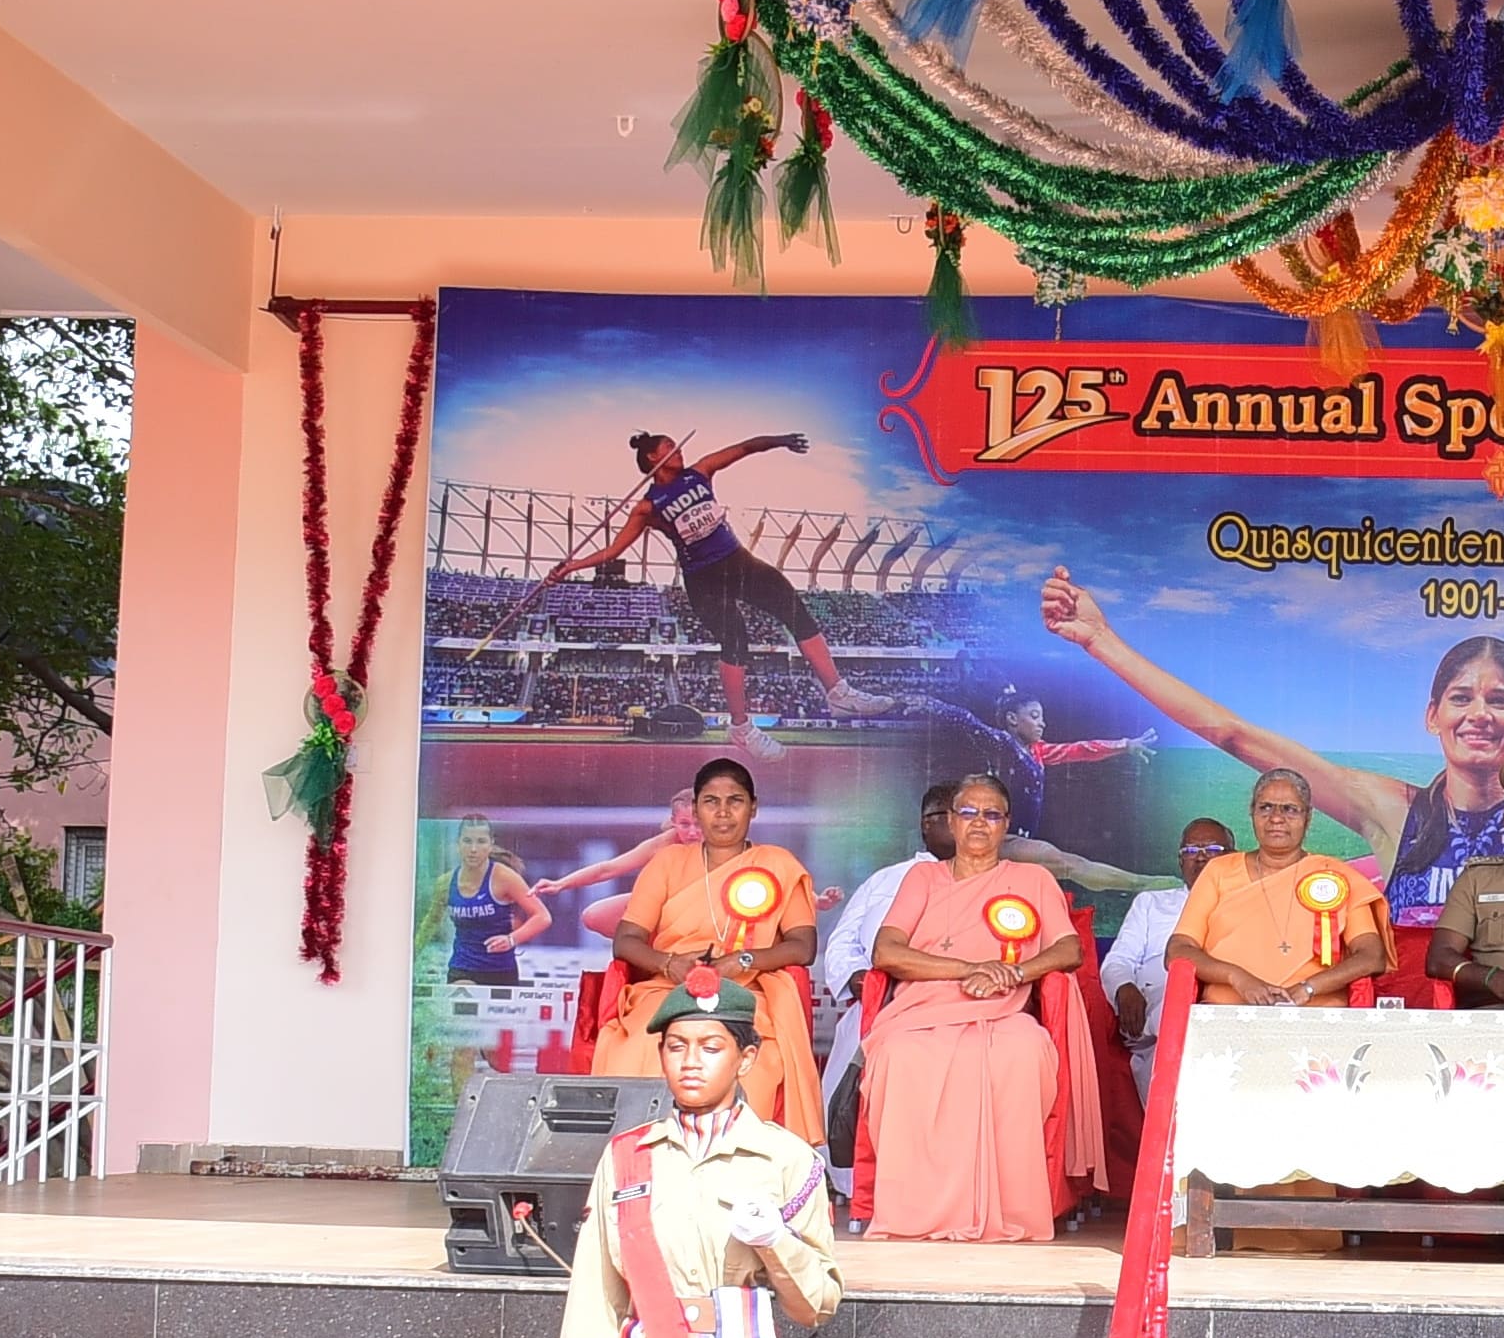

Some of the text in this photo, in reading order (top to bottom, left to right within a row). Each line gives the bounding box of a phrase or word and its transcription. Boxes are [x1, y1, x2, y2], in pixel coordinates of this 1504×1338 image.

[1141, 375, 1378, 435] Annual
[662, 483, 710, 521] INDIA
[688, 512, 715, 532] RANI
